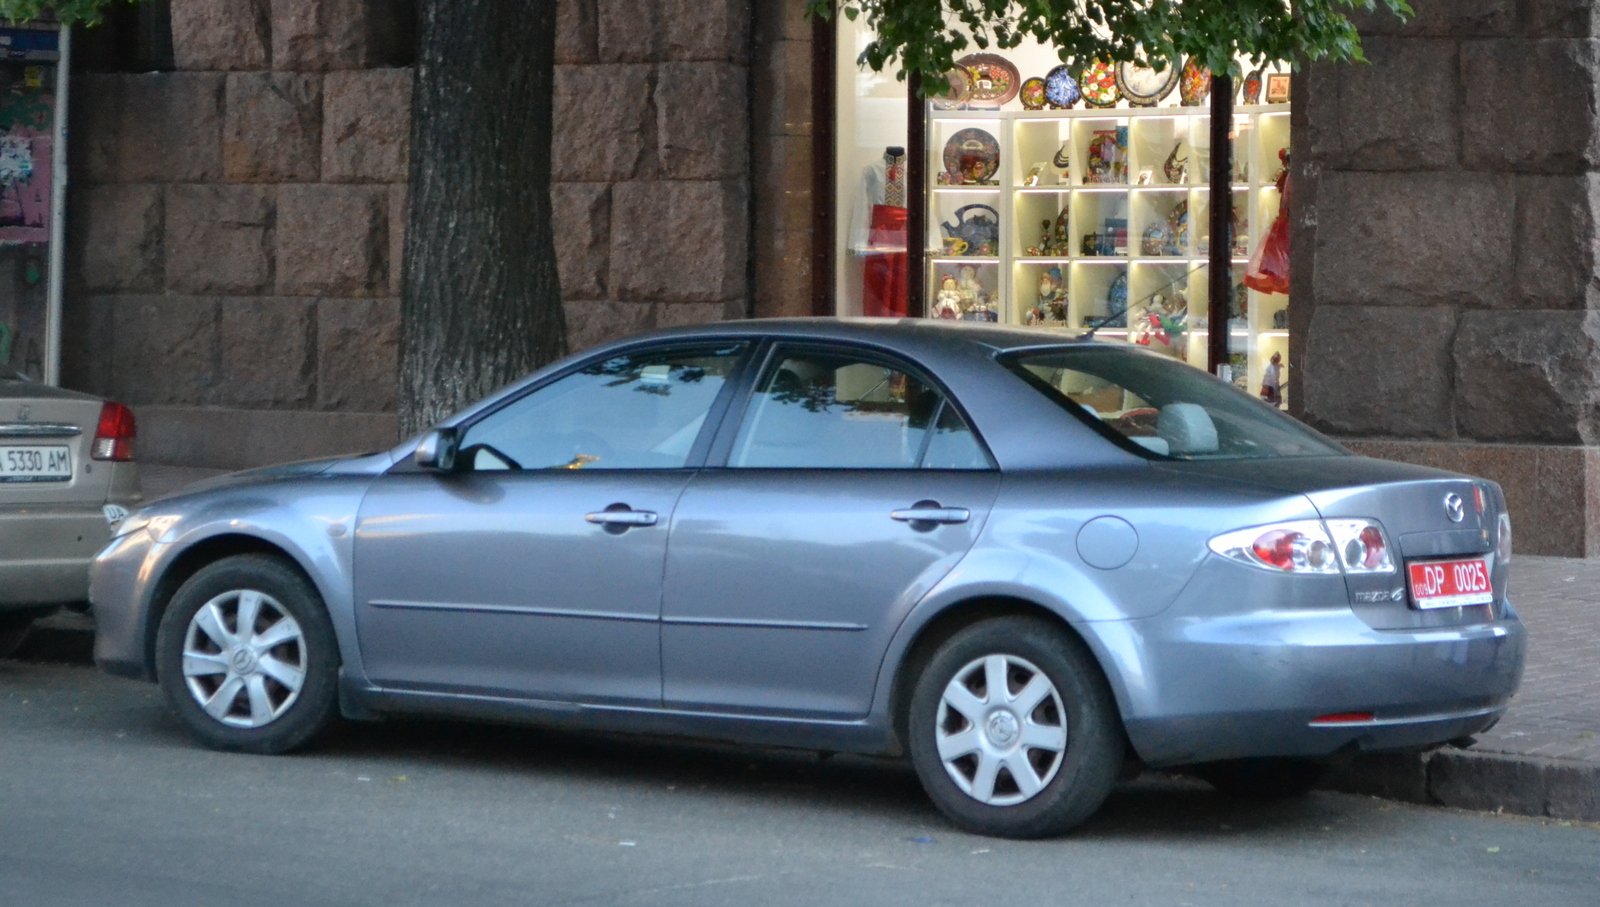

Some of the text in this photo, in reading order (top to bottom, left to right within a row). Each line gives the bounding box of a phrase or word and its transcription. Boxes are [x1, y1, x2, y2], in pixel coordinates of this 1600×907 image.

[7, 450, 42, 471] 5330
[48, 450, 68, 471] AM
[105, 506, 124, 519] UA
[1424, 565, 1445, 595] DP
[1454, 562, 1487, 592] 0025
